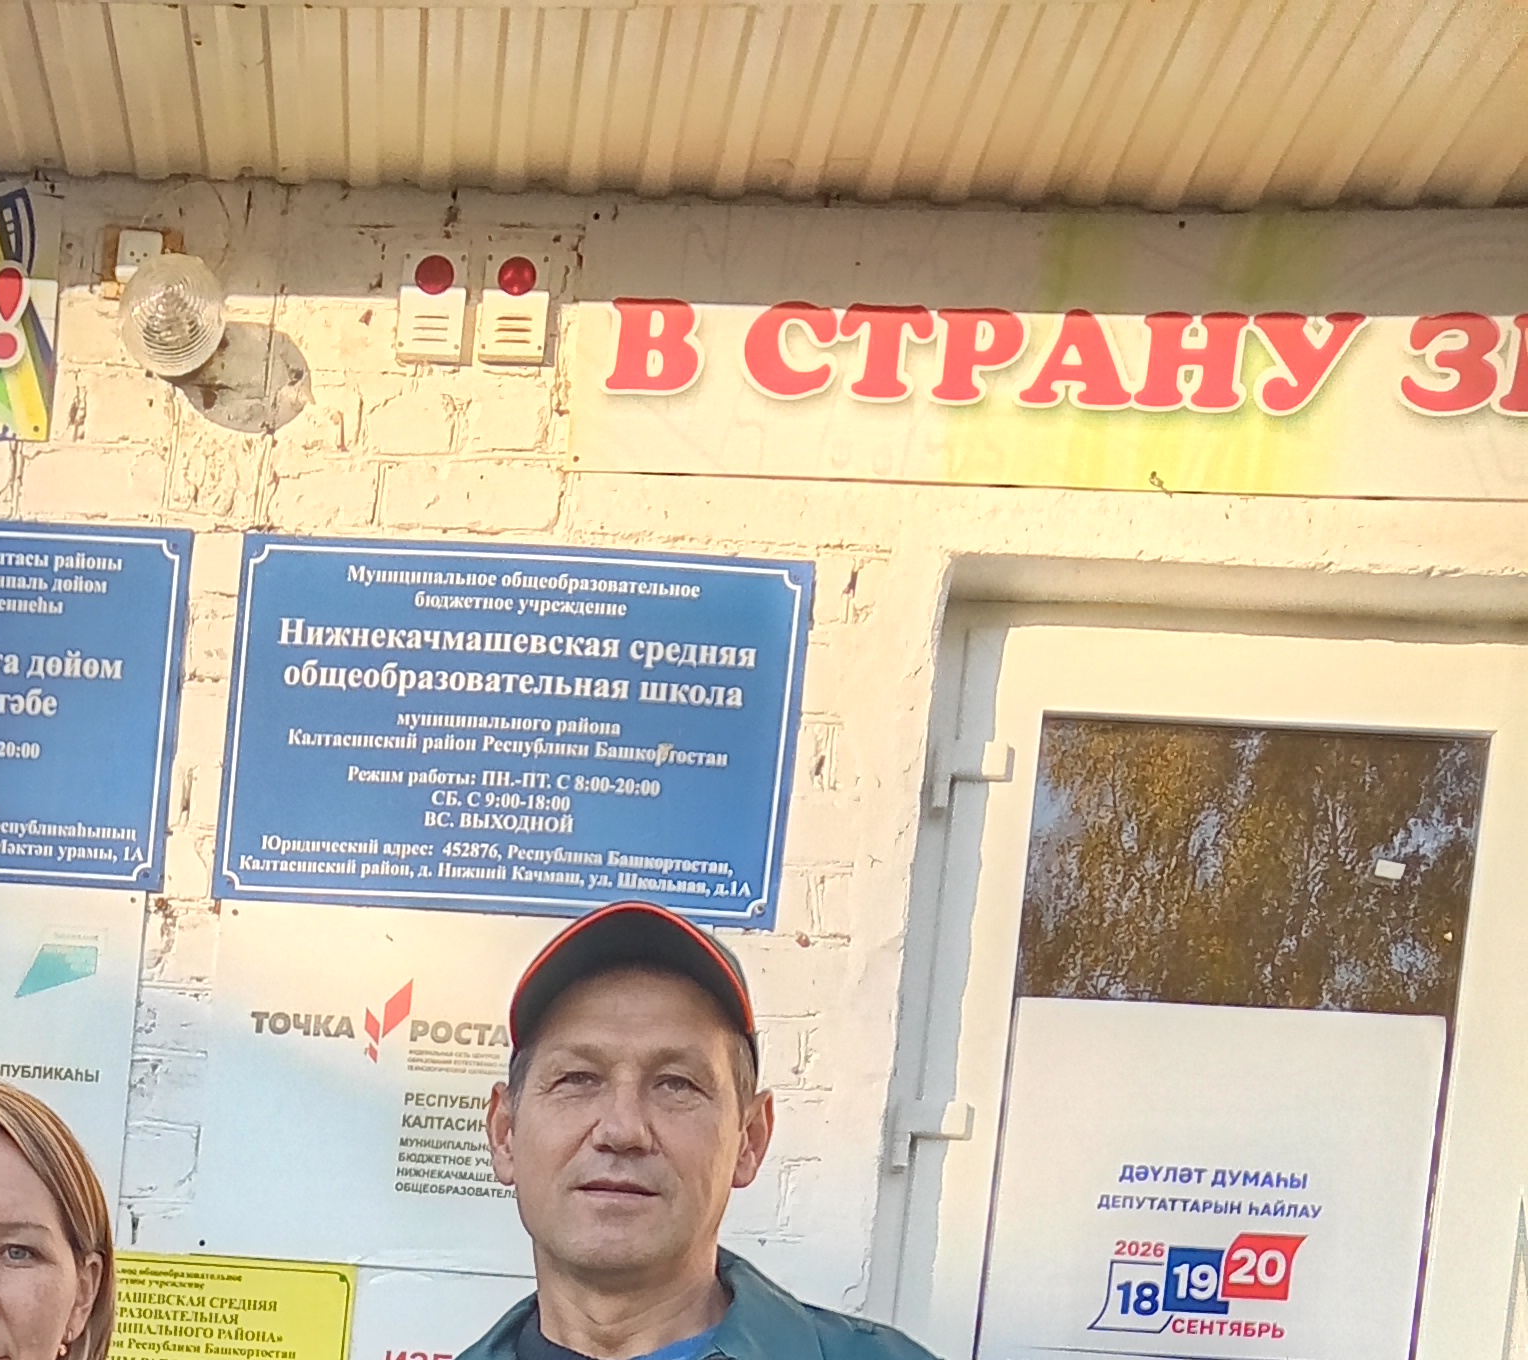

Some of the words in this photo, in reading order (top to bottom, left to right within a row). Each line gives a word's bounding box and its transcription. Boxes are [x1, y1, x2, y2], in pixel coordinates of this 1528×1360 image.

[603, 296, 703, 395] В
[743, 300, 1367, 413] СТРАНУ
[1399, 311, 1528, 414] З
[52, 551, 123, 573] районы
[347, 564, 497, 588] Муниципальное
[501, 571, 701, 599] общеобразовательное
[414, 591, 514, 611] бюджетное
[517, 598, 628, 617] учреждение
[277, 617, 621, 660] Нижнекачмашевская
[629, 638, 758, 670] средняя
[26, 649, 124, 680] дөйөм
[283, 658, 630, 702] общеобразовательная
[638, 680, 744, 709] школа
[396, 712, 552, 733] муниципального
[555, 717, 621, 737] района
[287, 728, 418, 751] Калтасинский
[421, 734, 477, 753] район
[480, 735, 590, 759] Республики
[347, 765, 404, 784] Режим
[407, 768, 477, 787] работы:
[480, 770, 552, 789] ПН.-ПТ.
[574, 774, 661, 797] 8:00-20:00
[430, 789, 463, 807] СБ.
[484, 792, 571, 812] 9:00-18:00
[424, 810, 455, 828] ВС.
[459, 813, 574, 834] ВЫХОДНОЙ
[56, 845, 119, 865] урамы,
[122, 846, 144, 862] 1А
[261, 834, 379, 856] Юридический
[382, 840, 434, 860] адрес:
[441, 840, 503, 862] 452876,
[507, 844, 603, 867] Республика
[607, 850, 734, 879] Башкортостан,
[239, 855, 357, 875] Калтасинский
[360, 860, 415, 879] район,
[437, 862, 507, 881] Нижний
[511, 866, 586, 888] Качмаш,
[587, 871, 613, 890] ул.
[616, 871, 712, 897] Школьная,
[251, 1010, 355, 1039] ТОЧКА
[409, 1019, 510, 1048] РОСТА
[403, 1091, 491, 1111] РЕСПУБЛИ
[401, 1113, 487, 1133] КАЛТАСИН
[398, 1137, 491, 1153] МУНИЦИПАЛЬНО
[397, 1151, 472, 1167] БЮДЖЕТНОЕ
[1118, 1164, 1208, 1189] ДӘҮЛӘТ
[1210, 1167, 1308, 1191] ДУМАҺЫ
[1097, 1194, 1242, 1217] ДЕПУТАТТАРЫН
[1247, 1198, 1323, 1221] ҺАЙЛАУ
[1114, 1240, 1166, 1259] 2026
[1227, 1248, 1288, 1287] 20
[1171, 1263, 1219, 1301] 19
[209, 1296, 278, 1312] СРЕДНЯЯ
[1115, 1280, 1160, 1317] 18
[116, 1322, 215, 1339] ЦИПАЛЬНОГО
[217, 1327, 284, 1343] РАЙОНА»
[1171, 1318, 1285, 1340] СЕНТЯБРЬ
[127, 1338, 201, 1355] Республики
[204, 1343, 297, 1360] Башкортостан
